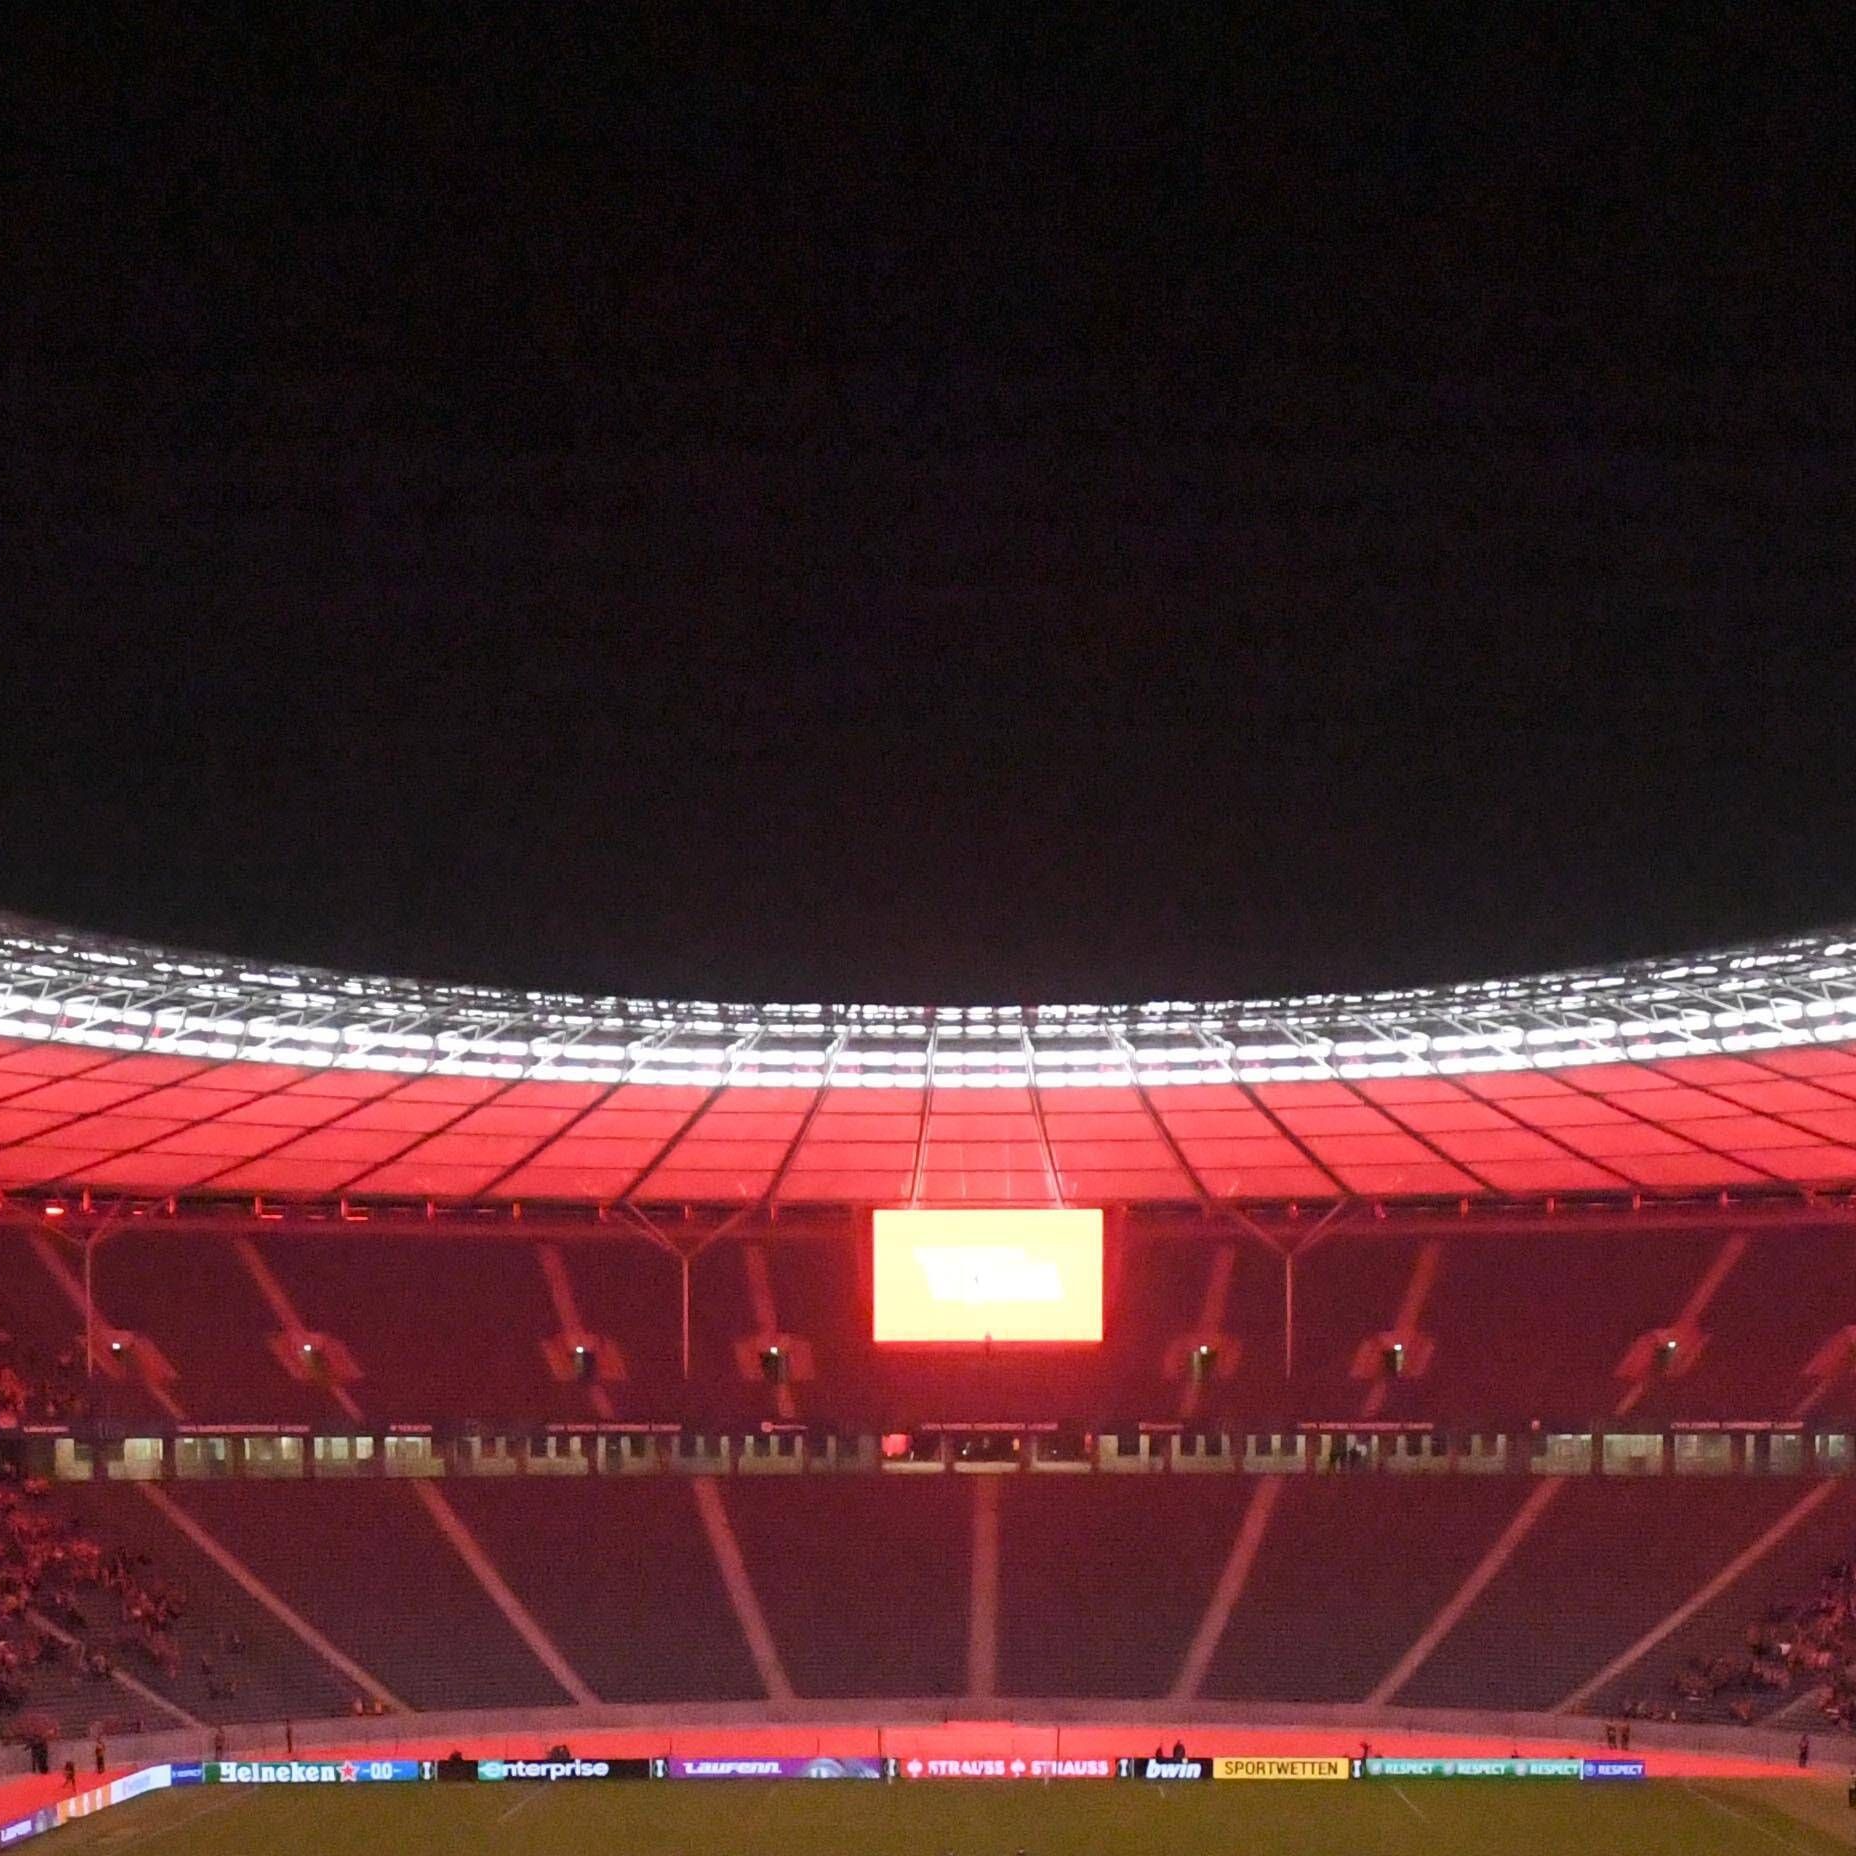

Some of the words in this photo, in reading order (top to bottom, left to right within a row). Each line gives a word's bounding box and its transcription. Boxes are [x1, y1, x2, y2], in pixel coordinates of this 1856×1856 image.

[219, 1762, 336, 1782] Heineken
[478, 1759, 609, 1781] enterprise
[928, 1760, 1005, 1776] STRAUSS
[1031, 1760, 1109, 1776] STRAUSS
[1145, 1758, 1202, 1778] bwin
[1224, 1761, 1339, 1776] SPORTWETTEN
[1384, 1763, 1433, 1775] RESPECT
[1457, 1763, 1505, 1775] RESPECT
[1530, 1763, 1579, 1775] RESPECT
[1598, 1764, 1643, 1776] RESPECT
